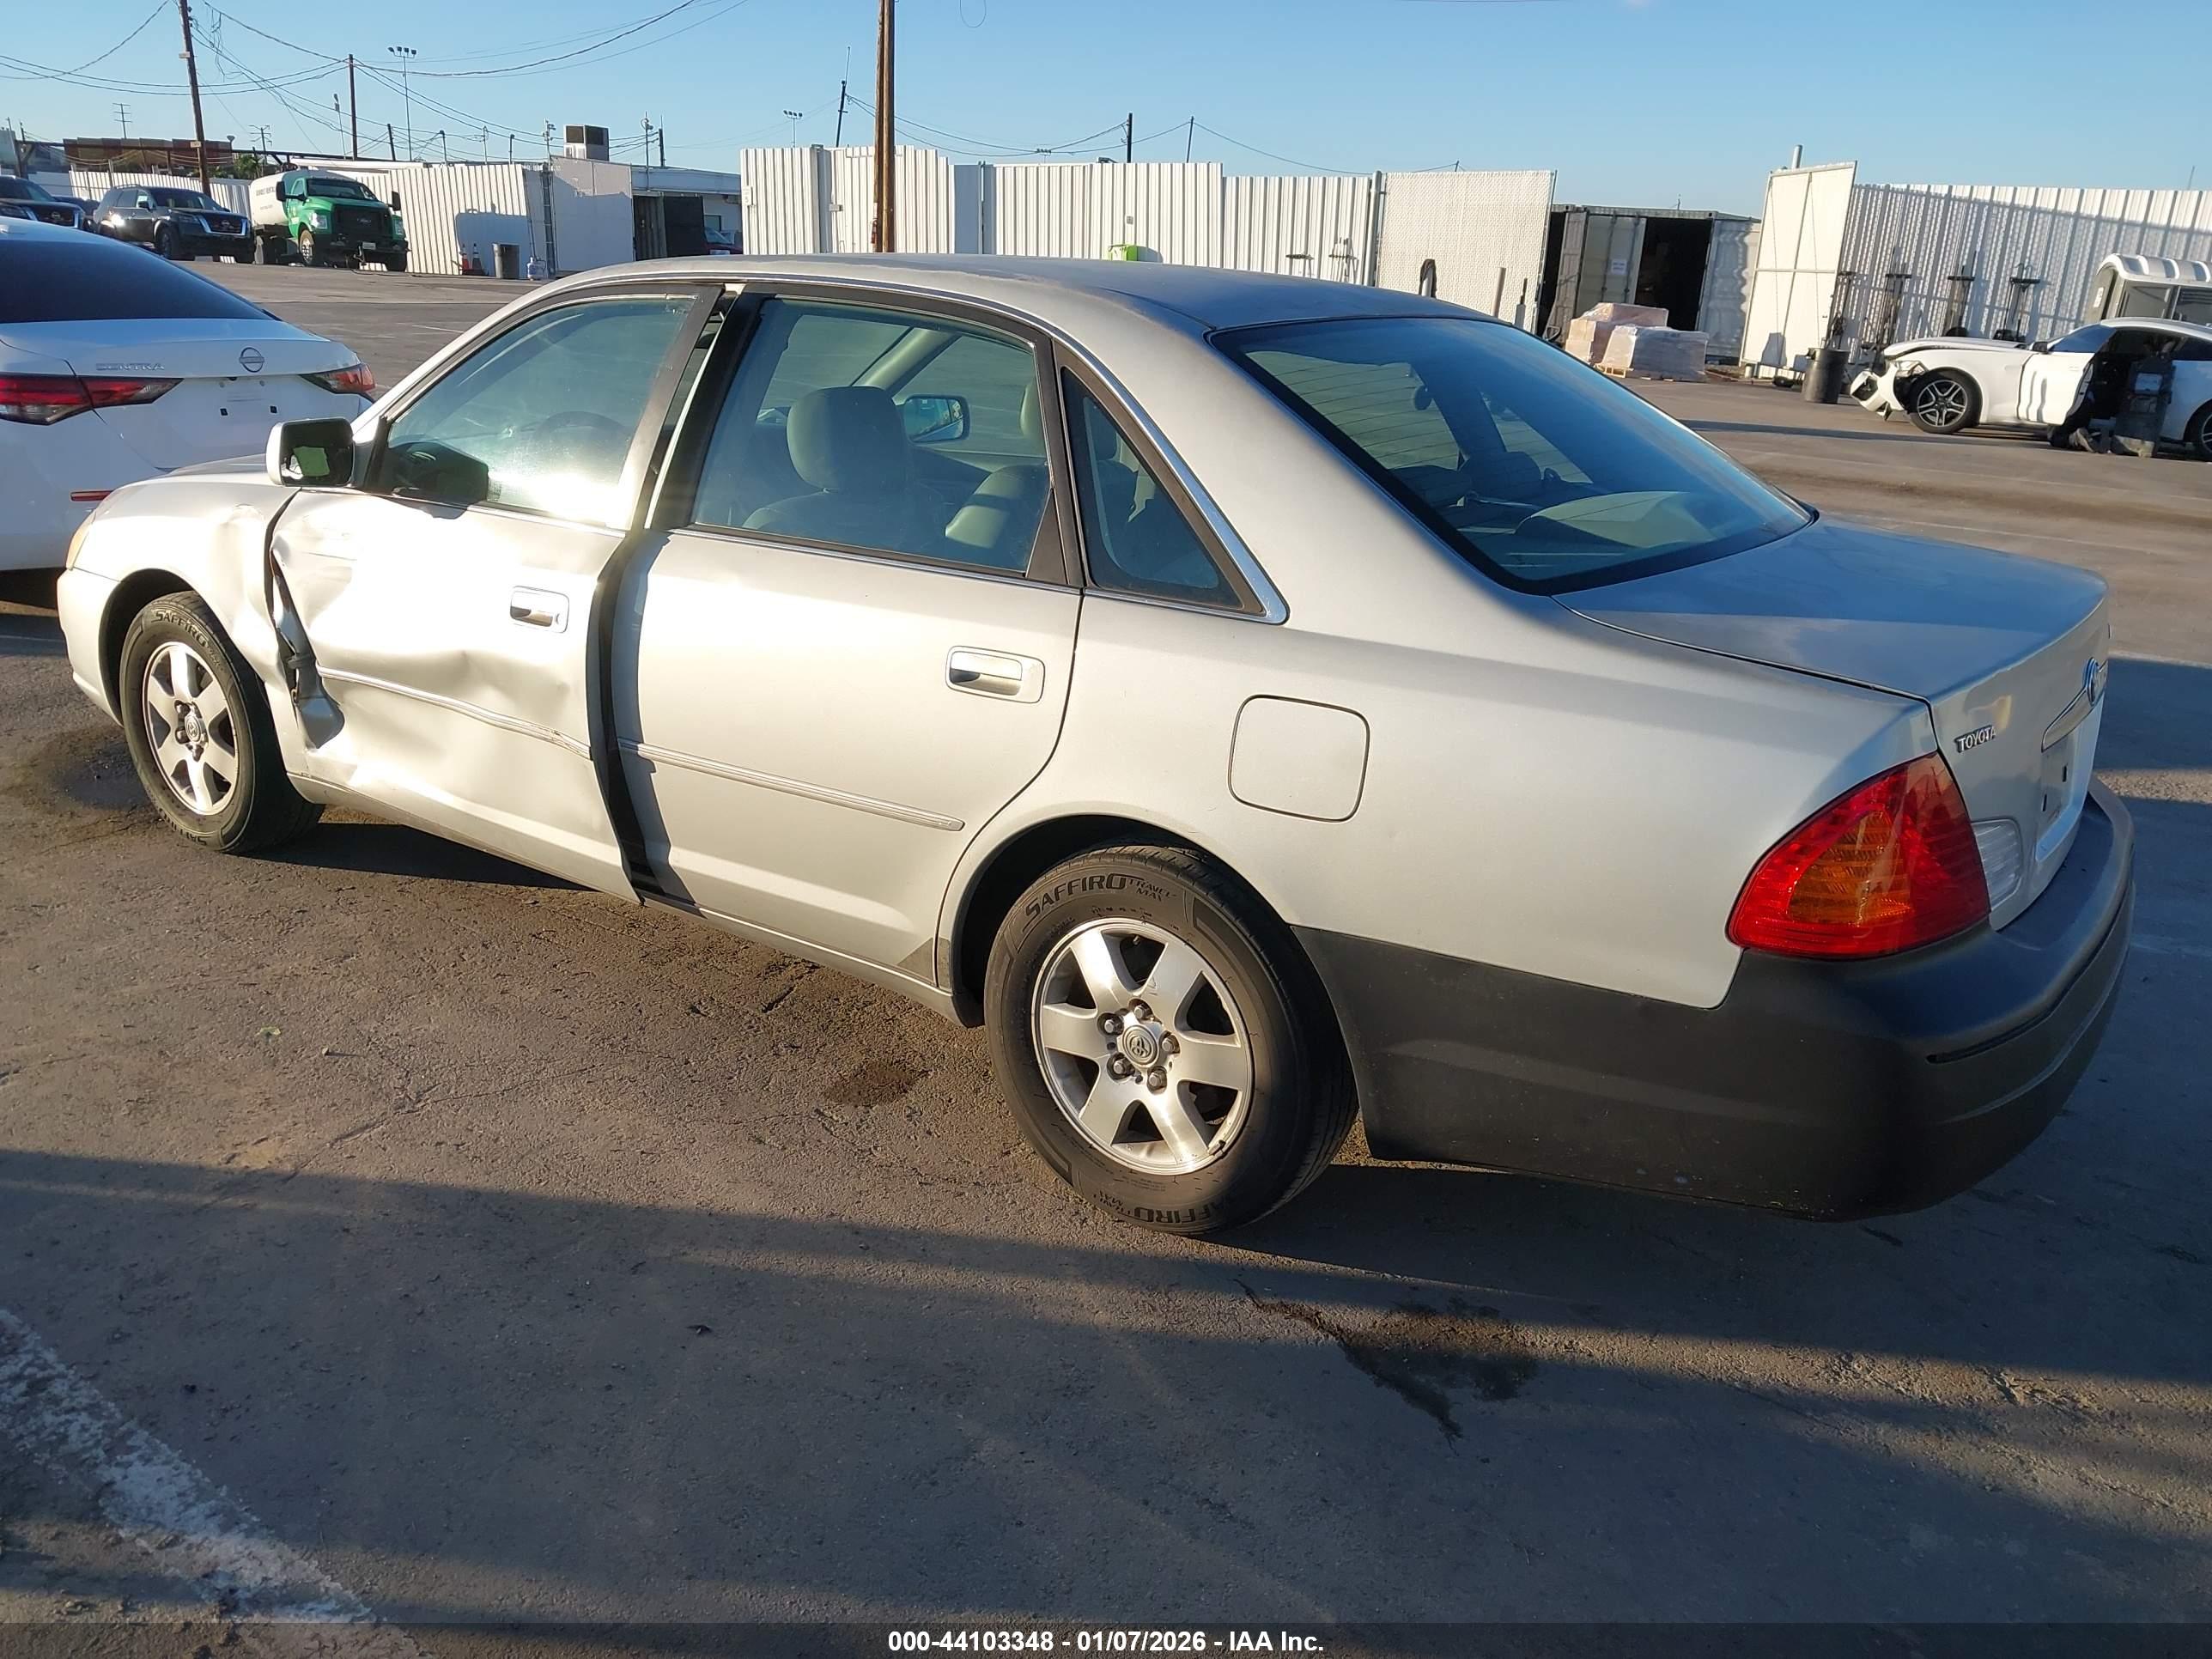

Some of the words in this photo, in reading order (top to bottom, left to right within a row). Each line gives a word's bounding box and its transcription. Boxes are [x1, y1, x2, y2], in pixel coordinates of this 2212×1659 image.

[151, 611, 208, 647] SAFFIRO
[1956, 725, 1996, 752] TOYOTA
[1022, 872, 1144, 933] SAFFIRO
